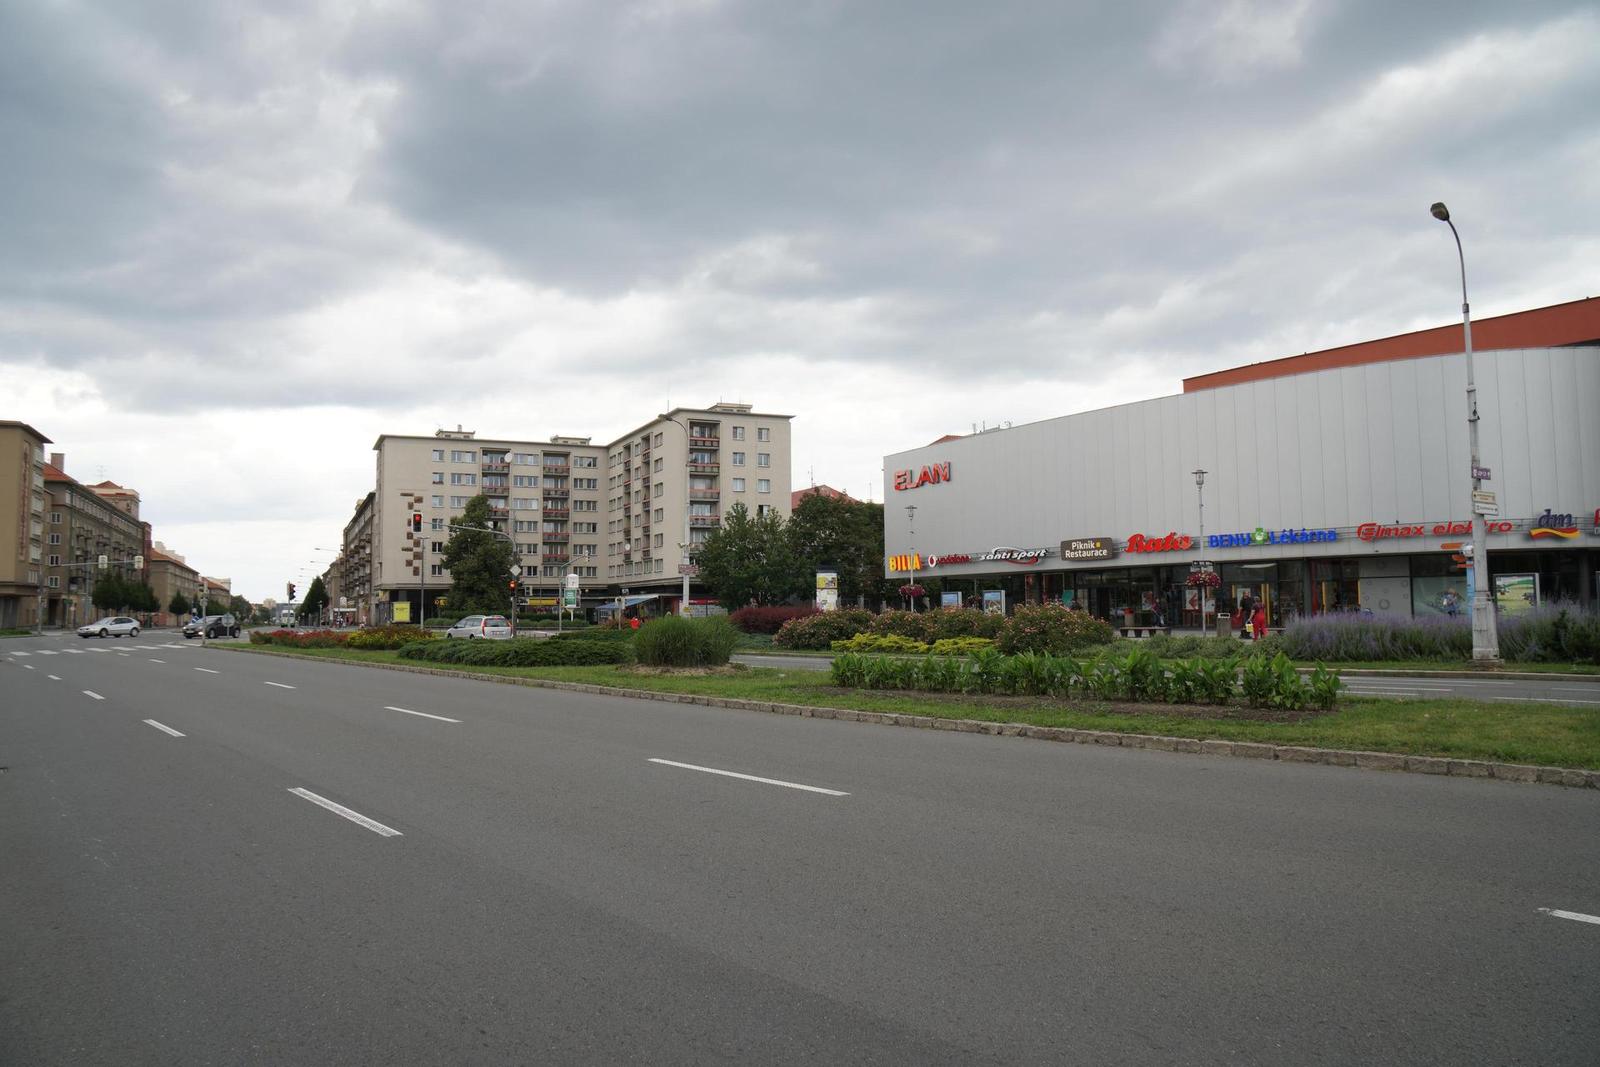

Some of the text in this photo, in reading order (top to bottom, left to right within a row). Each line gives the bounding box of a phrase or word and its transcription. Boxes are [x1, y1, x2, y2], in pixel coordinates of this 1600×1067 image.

[895, 461, 951, 490] ELAN
[1538, 508, 1573, 528] dm
[1433, 520, 1513, 535] elekro
[1071, 541, 1095, 550] Piknik
[1208, 528, 1336, 548] BENU Lékárna
[1012, 550, 1047, 560] sport
[1065, 548, 1108, 558] Restaurace
[889, 553, 922, 572] BILLA
